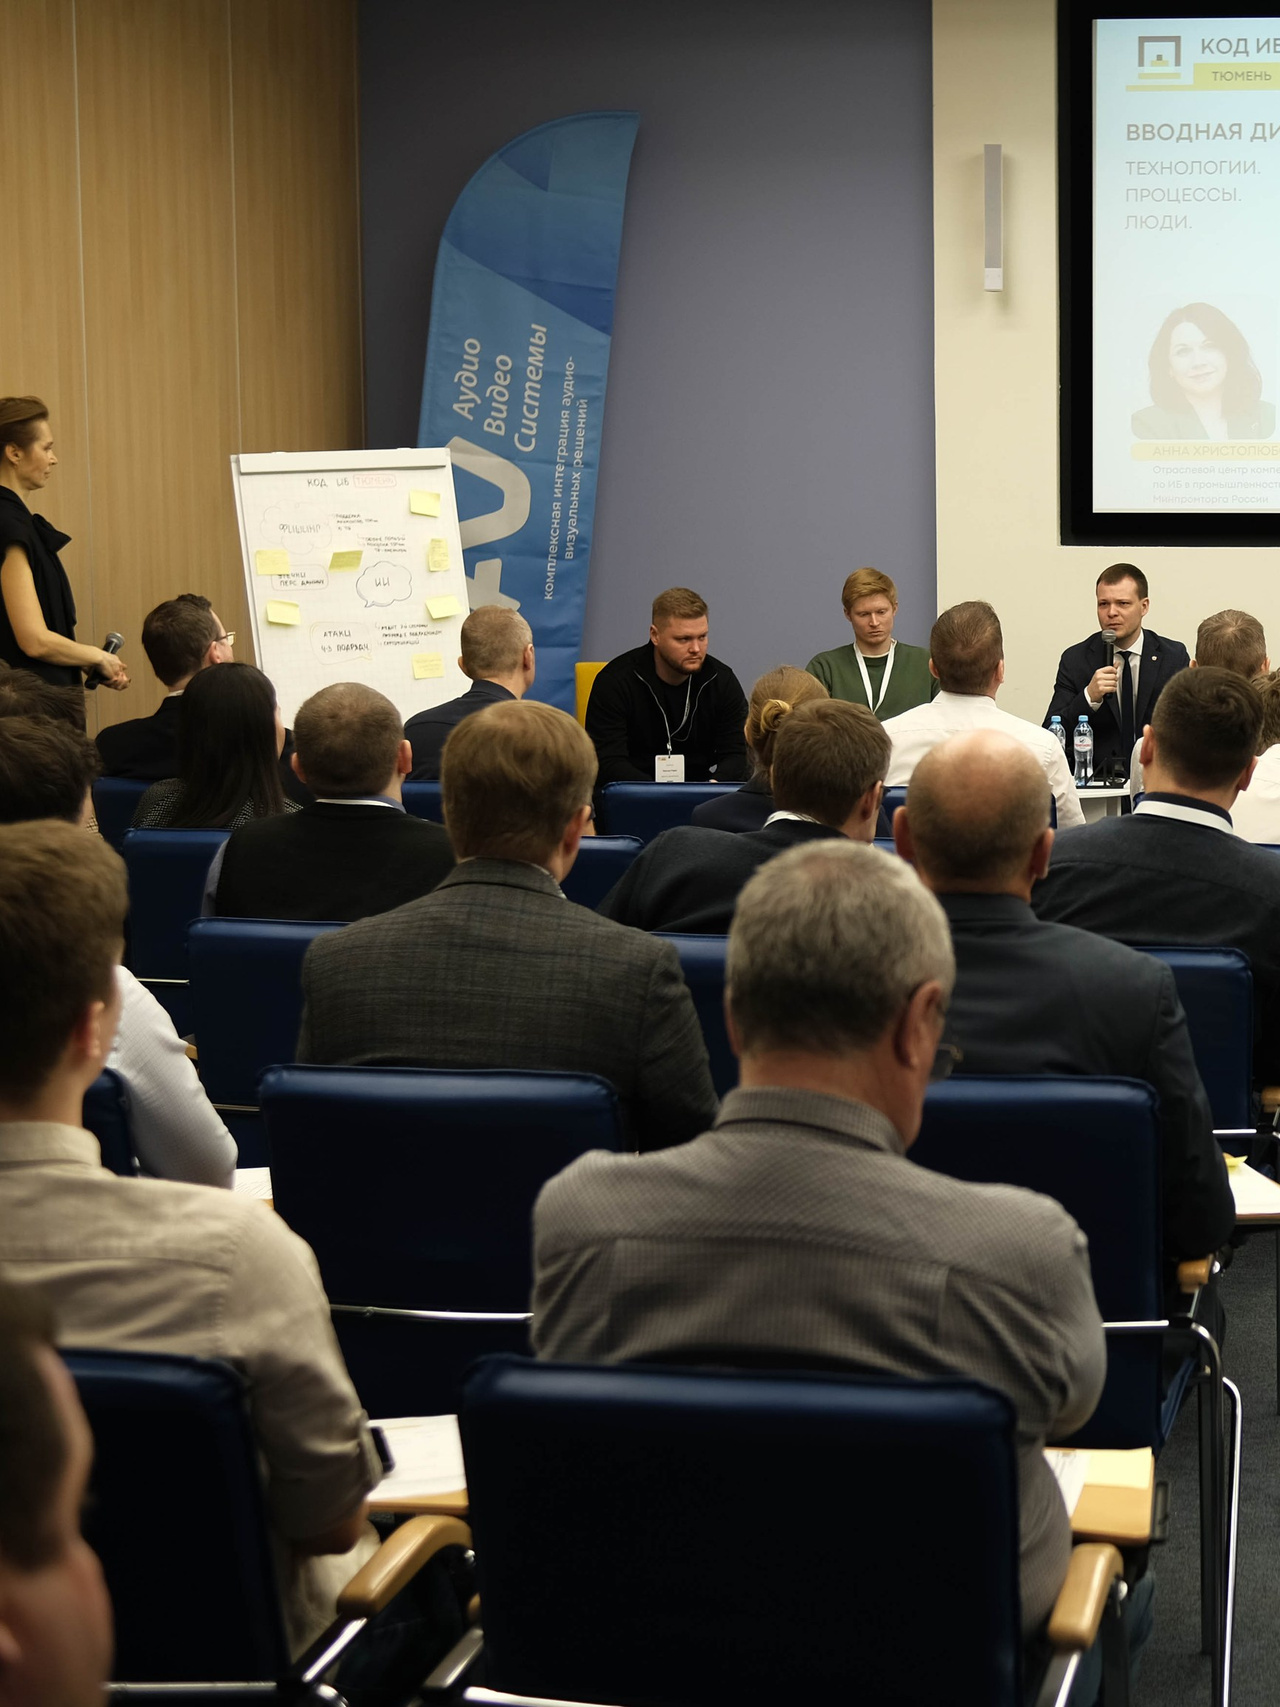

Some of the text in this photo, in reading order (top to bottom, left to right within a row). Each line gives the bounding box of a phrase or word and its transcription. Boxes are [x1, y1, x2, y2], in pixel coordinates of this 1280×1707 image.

[1201, 37, 1250, 57] КОД
[1211, 70, 1272, 82] ТЮМЕНЬ
[1125, 122, 1243, 143] ВВОДНАЯ
[1125, 160, 1262, 176] ТЕХНОЛОГИИ.
[1125, 187, 1242, 204] ПРОЦЕССЫ.
[1124, 214, 1193, 231] ЛЮДИ.
[452, 338, 482, 421] Аудио
[514, 323, 547, 452] Системы
[483, 354, 513, 436] Видео
[1152, 445, 1190, 457] АННА
[544, 356, 576, 600] комплексная интеграция аудио-
[564, 398, 588, 560] визуальных решений
[1152, 465, 1216, 476] Отраслевой
[1218, 466, 1249, 476] центр
[307, 478, 328, 488] КОД
[1152, 481, 1166, 489] по
[1168, 480, 1182, 489] ИБ
[1231, 494, 1269, 504] России
